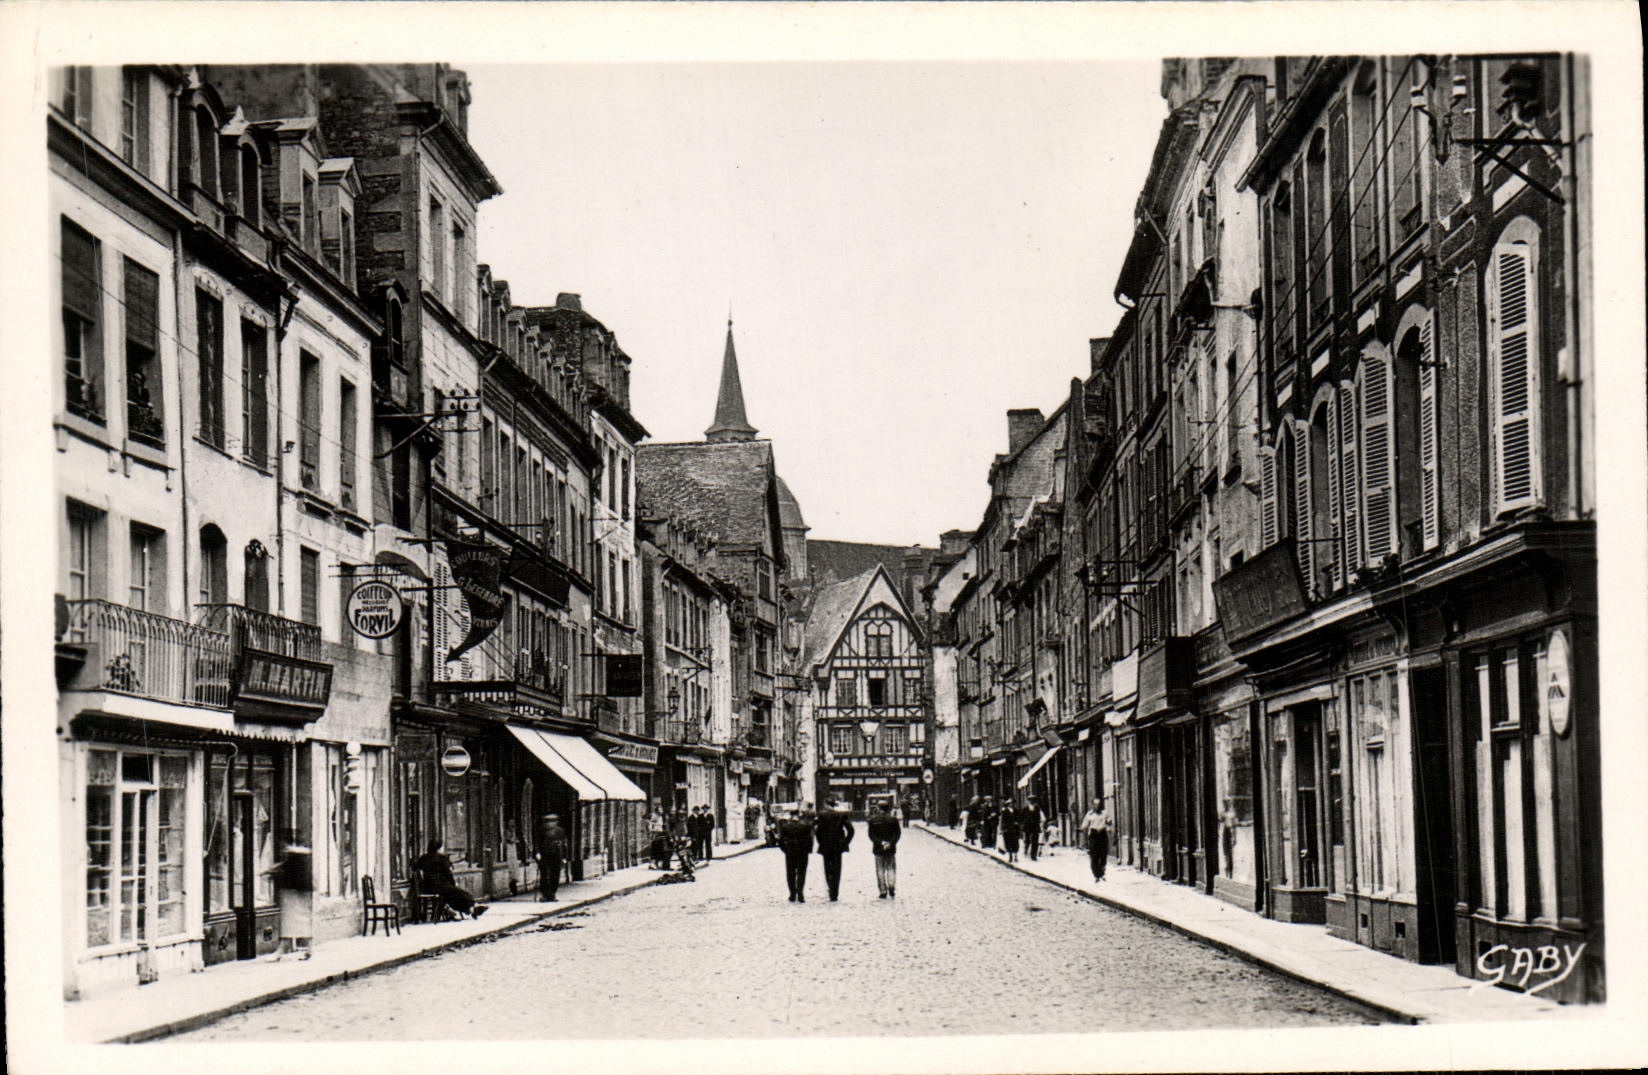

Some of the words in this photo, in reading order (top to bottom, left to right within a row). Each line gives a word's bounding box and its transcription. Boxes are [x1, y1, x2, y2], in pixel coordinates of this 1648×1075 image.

[451, 551, 498, 569] COULEURS
[356, 585, 393, 600] COIFFEUR
[354, 608, 396, 635] FORVIL
